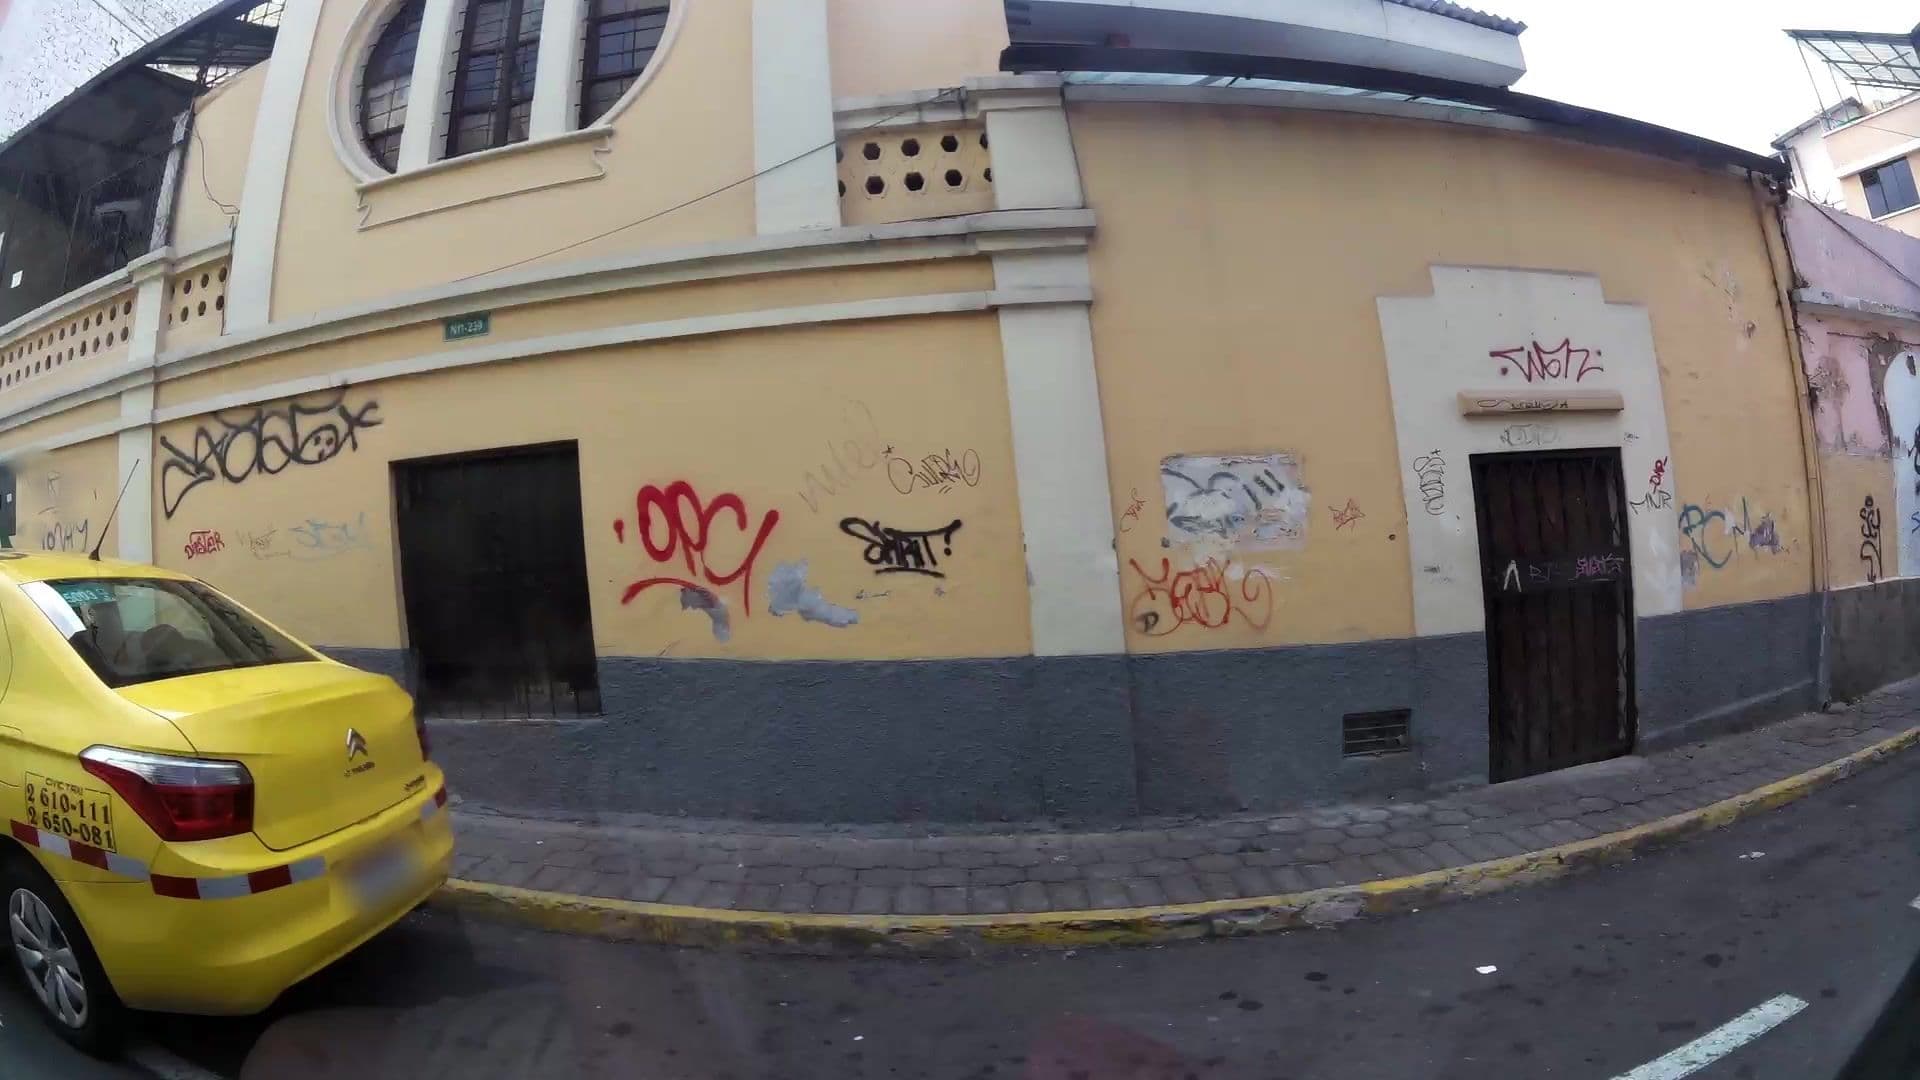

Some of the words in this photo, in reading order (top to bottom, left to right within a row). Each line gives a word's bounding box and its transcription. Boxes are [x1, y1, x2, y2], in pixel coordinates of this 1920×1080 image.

[27, 784, 35, 803] 2
[41, 788, 110, 824] 610-111
[28, 806, 38, 825] 2
[42, 811, 114, 850] 650-081
